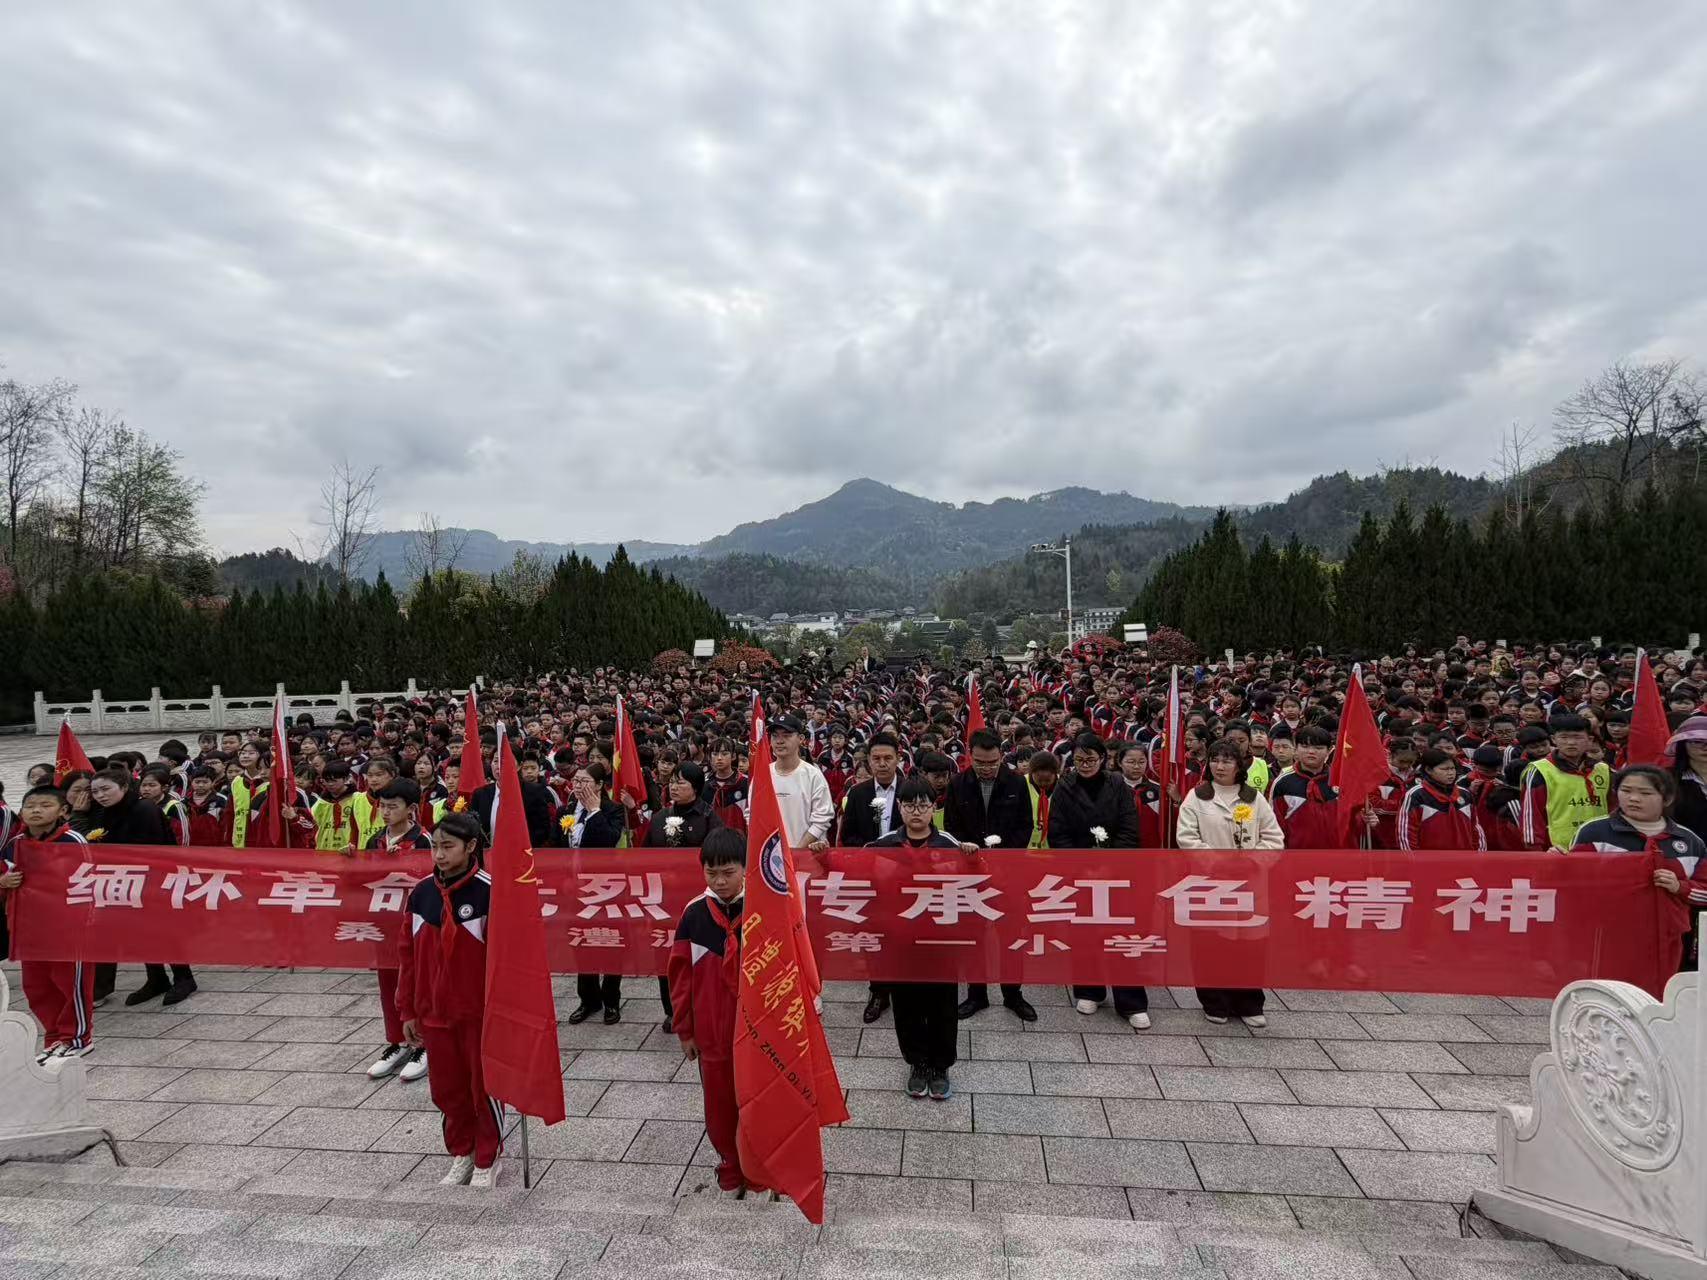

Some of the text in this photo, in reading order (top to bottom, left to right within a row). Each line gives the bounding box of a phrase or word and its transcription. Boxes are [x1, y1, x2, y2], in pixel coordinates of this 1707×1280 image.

[66, 862, 672, 921] 缅怀革命烈
